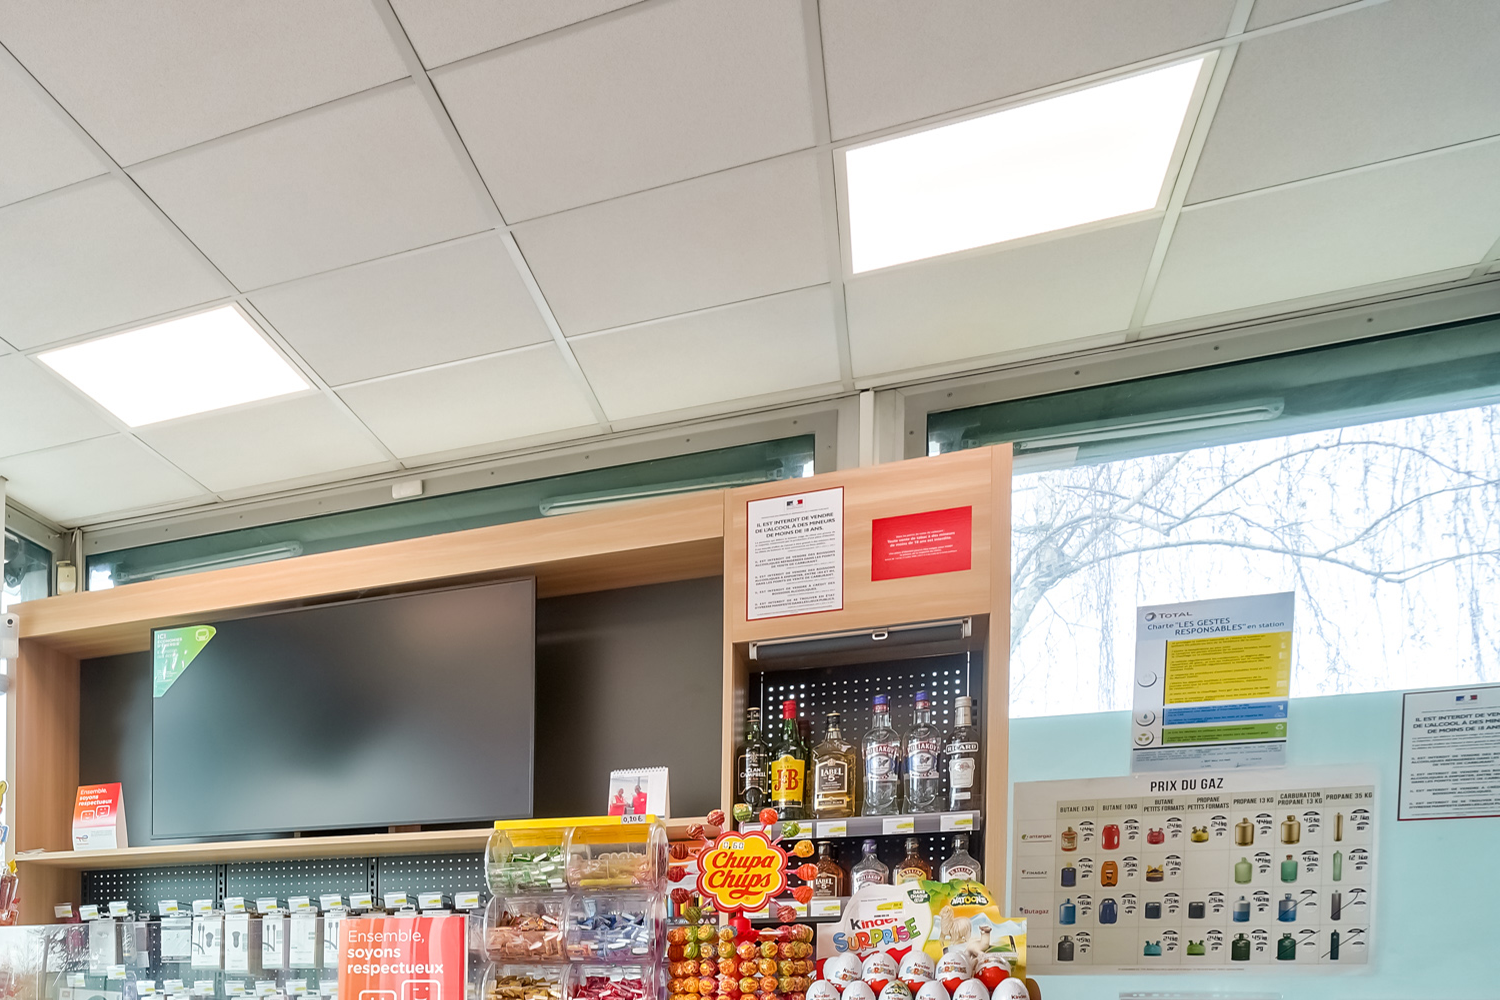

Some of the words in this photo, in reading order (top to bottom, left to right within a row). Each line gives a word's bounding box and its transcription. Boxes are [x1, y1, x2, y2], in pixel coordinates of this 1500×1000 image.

[762, 520, 773, 528] EST
[774, 517, 800, 526] INTERDIT
[801, 515, 810, 523] DE
[810, 512, 834, 521] VENDRE
[798, 520, 808, 528] DES
[809, 518, 836, 526] MINEURS
[775, 529, 793, 538] MOINS
[1159, 611, 1193, 619] TOTAL
[1147, 623, 1174, 631] Charte
[1197, 617, 1230, 627] GESTES
[1258, 620, 1285, 629] station
[947, 742, 978, 753] RICARD
[820, 767, 844, 777] LABEL
[1150, 780, 1177, 793] PRIX
[1181, 779, 1197, 791] DU
[1201, 778, 1224, 790] GAZ
[1162, 804, 1185, 812] FORMATS
[712, 851, 775, 874] Chupa
[708, 869, 771, 897] Chups
[1024, 908, 1049, 916] Butagaz
[348, 929, 425, 944] Ensemble,
[833, 917, 921, 952] SURPRISE
[347, 947, 401, 961] soyons
[347, 963, 444, 976] respectueux
